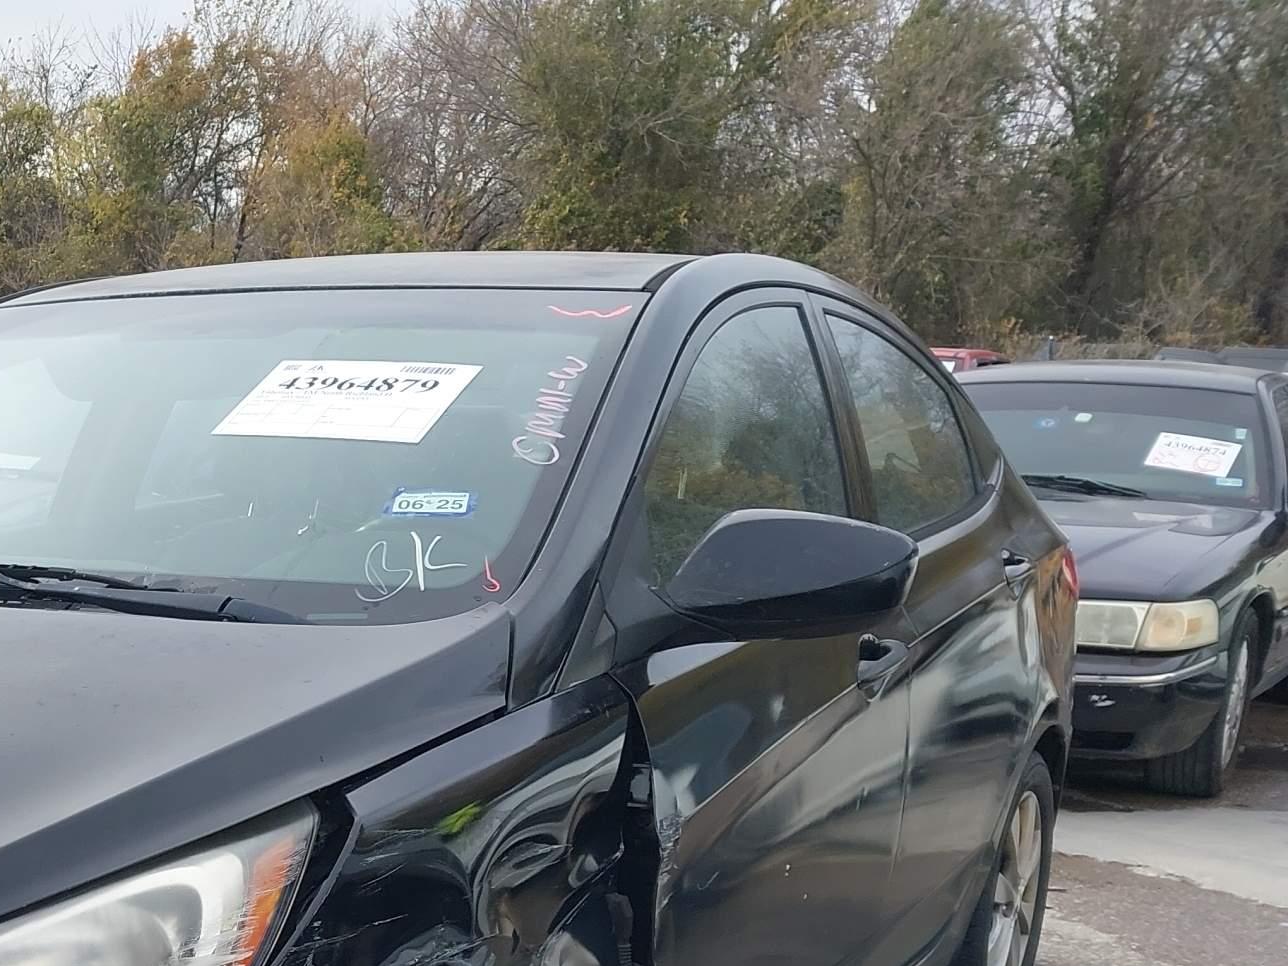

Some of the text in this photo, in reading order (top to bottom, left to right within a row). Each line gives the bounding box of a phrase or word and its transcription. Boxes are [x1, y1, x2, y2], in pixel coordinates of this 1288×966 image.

[279, 376, 440, 393] 43964879
[398, 499, 464, 510] 06 25
